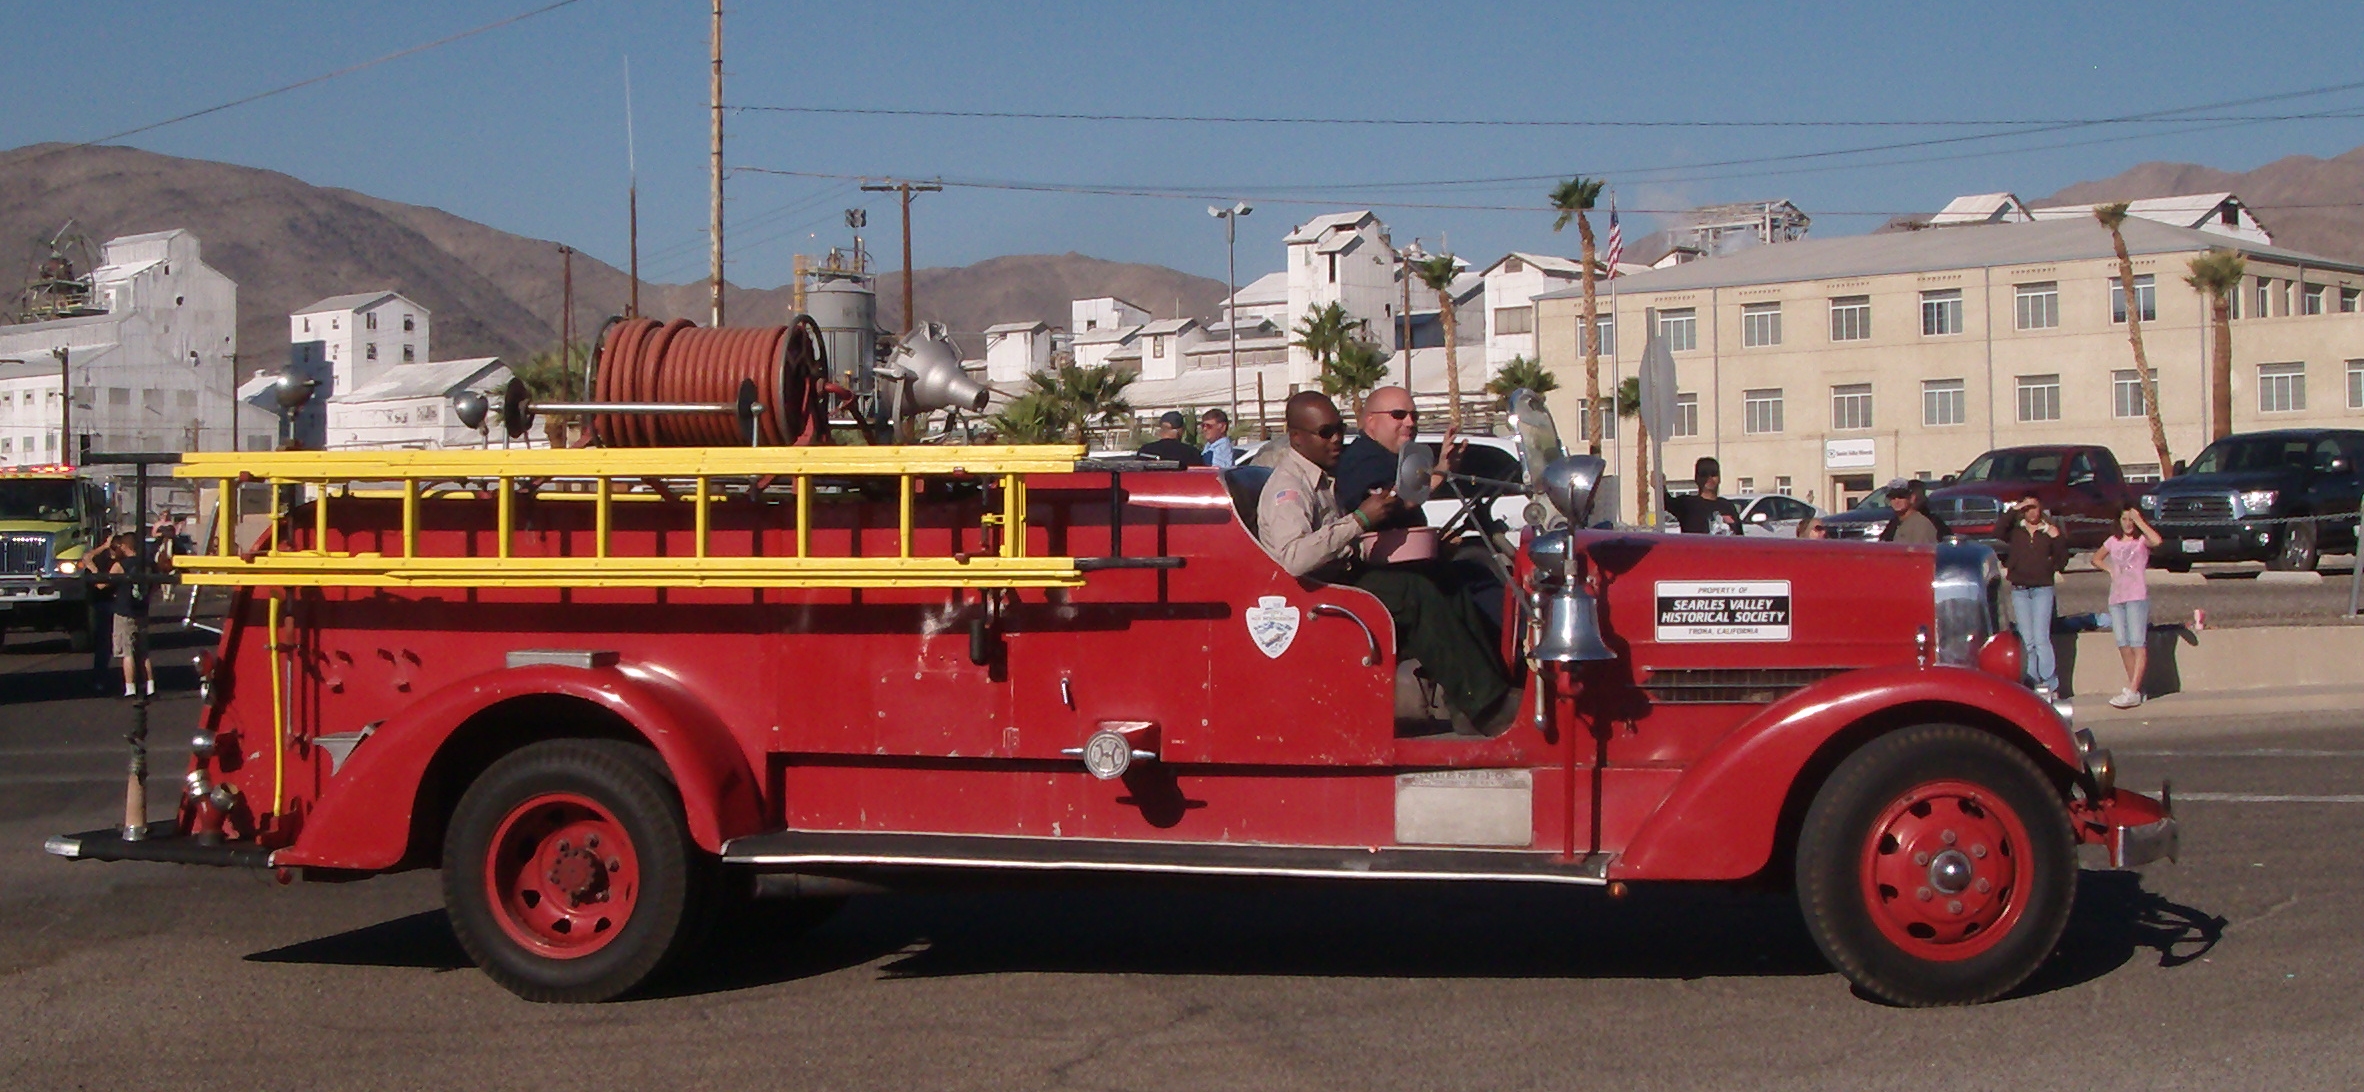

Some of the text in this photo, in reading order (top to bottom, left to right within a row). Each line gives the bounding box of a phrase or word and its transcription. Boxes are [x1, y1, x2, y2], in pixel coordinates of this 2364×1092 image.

[1673, 599, 1774, 611] SEARLES VALLEY
[1661, 611, 1786, 623] HISTORICAL SOCIETY
[1716, 627, 1759, 635] CALIFORNIA
